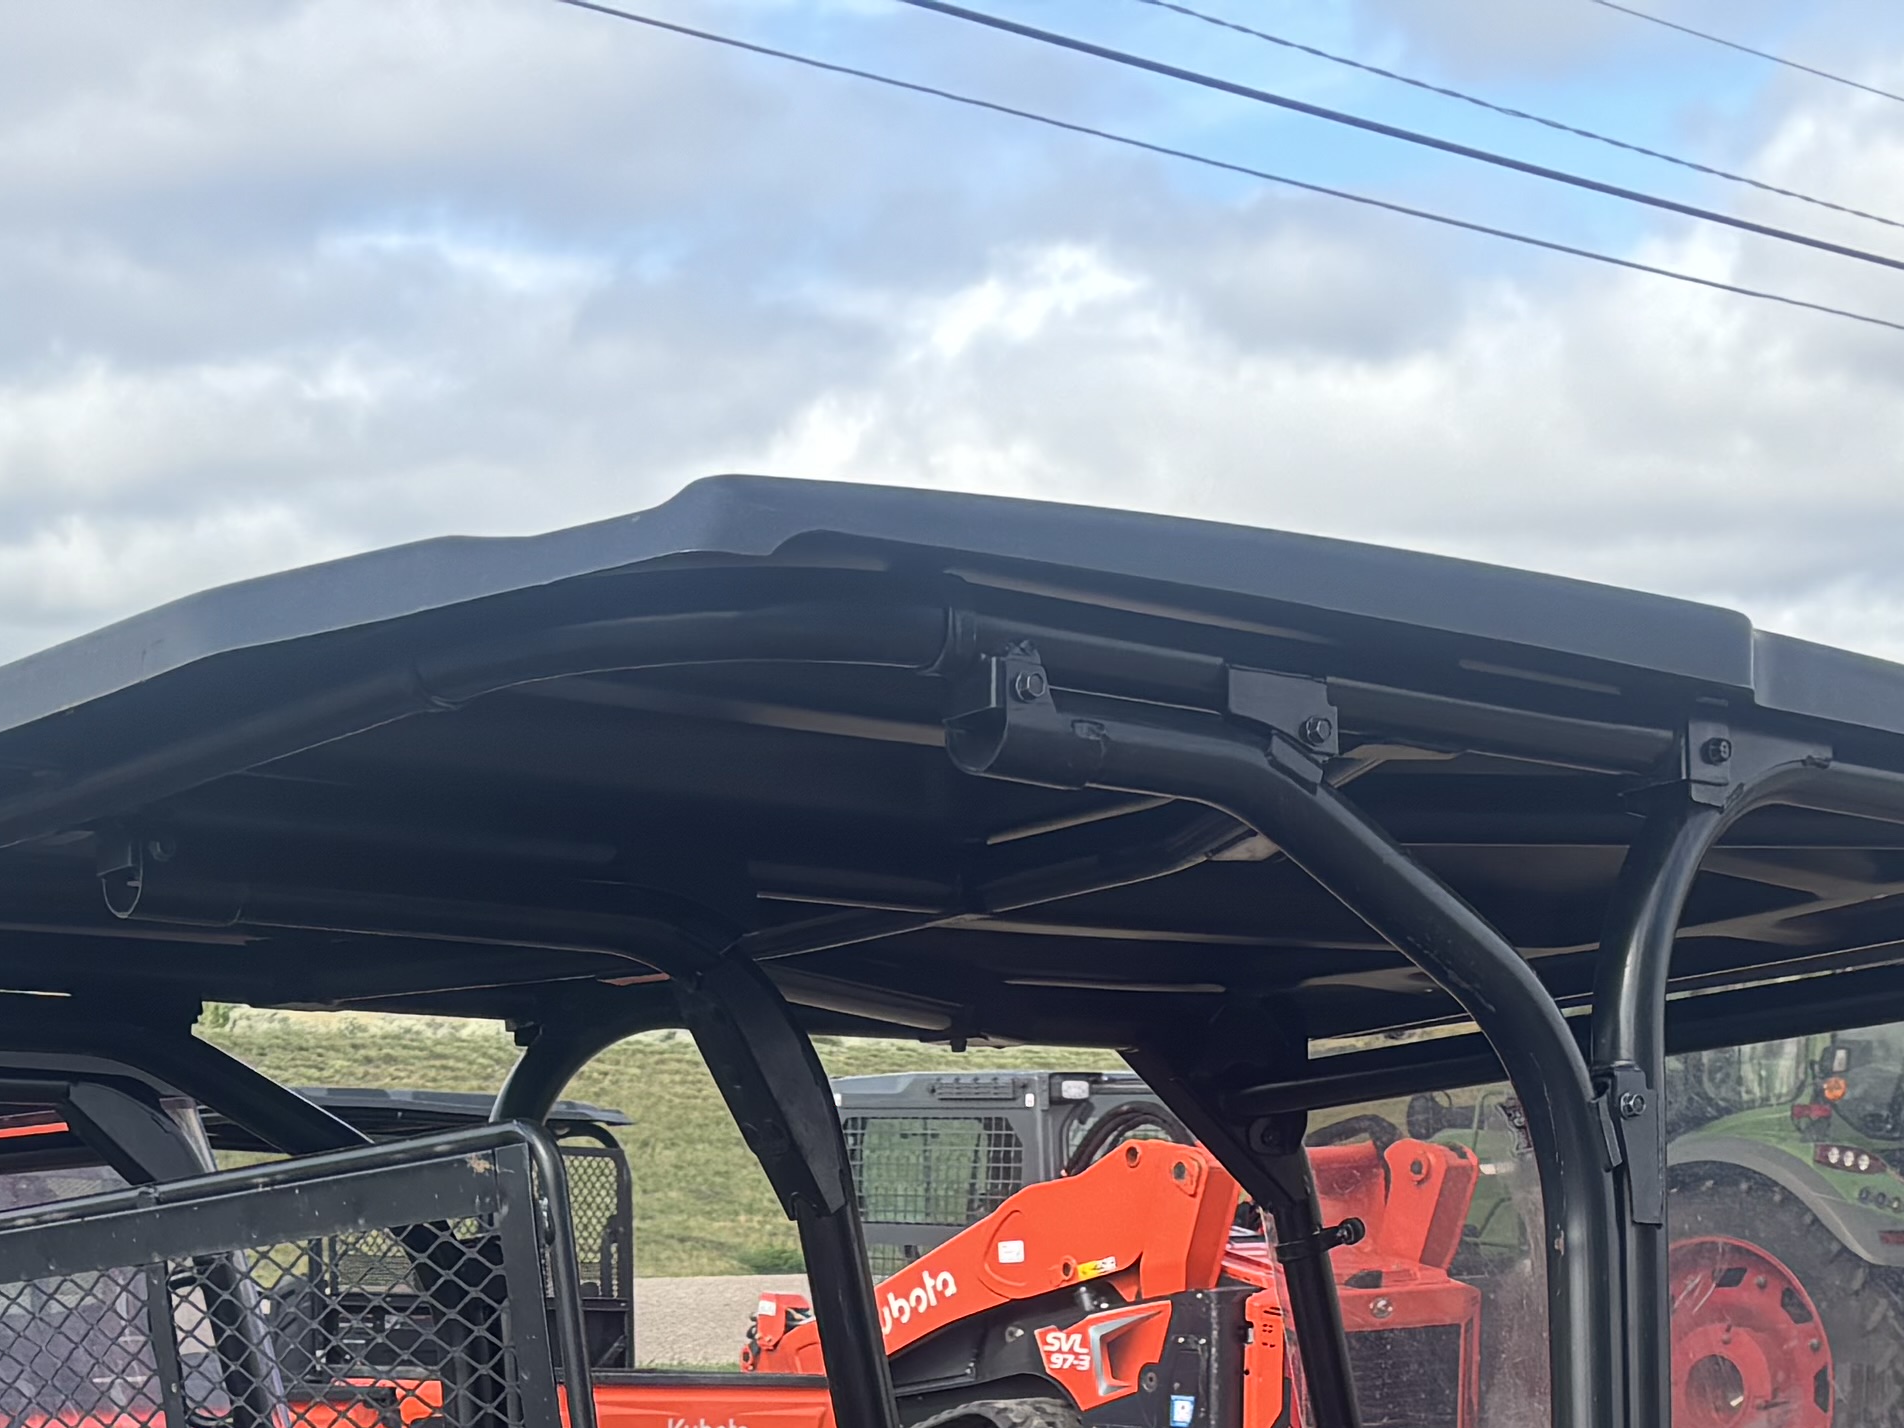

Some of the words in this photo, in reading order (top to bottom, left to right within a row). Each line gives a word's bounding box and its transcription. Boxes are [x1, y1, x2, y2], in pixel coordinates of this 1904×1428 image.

[882, 1270, 957, 1335] ubota
[1043, 1331, 1089, 1353] SVL
[1049, 1353, 1091, 1371] 97-3
